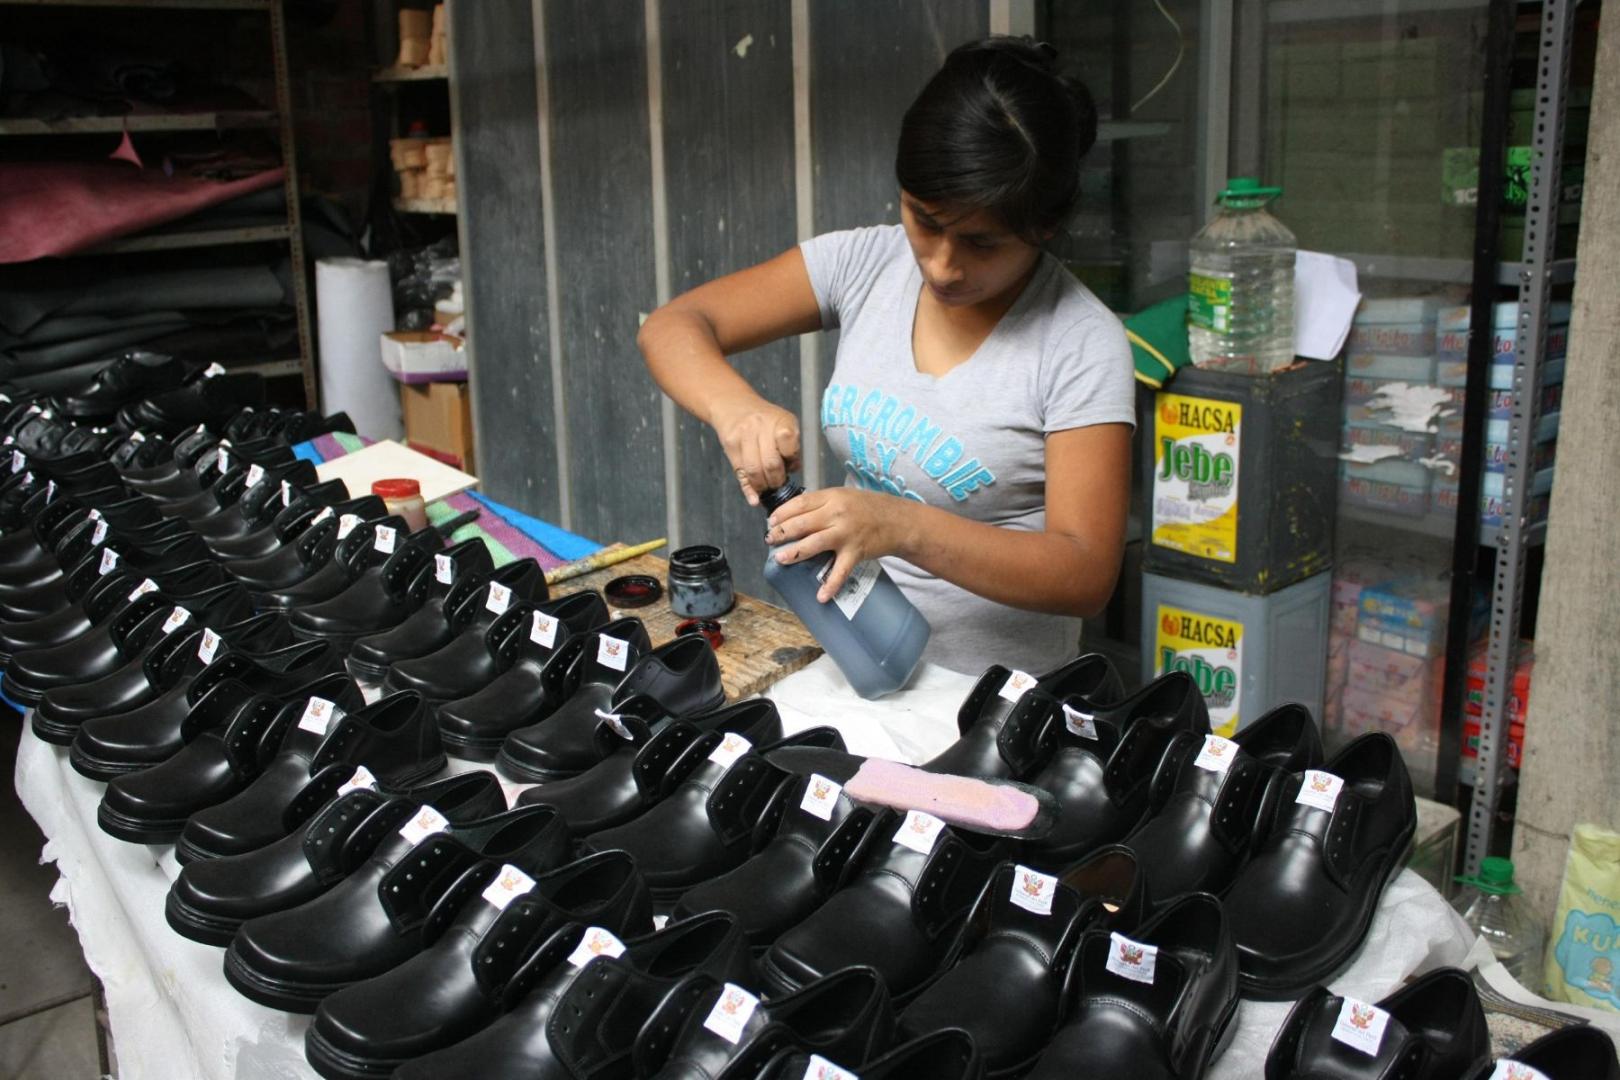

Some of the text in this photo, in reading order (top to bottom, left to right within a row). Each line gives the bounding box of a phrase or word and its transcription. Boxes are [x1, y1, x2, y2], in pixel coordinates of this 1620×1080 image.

[1180, 403, 1234, 433] HACSA
[1159, 436, 1234, 489] Jebe
[1180, 616, 1235, 649] HACSA
[1574, 925, 1620, 953] KU
